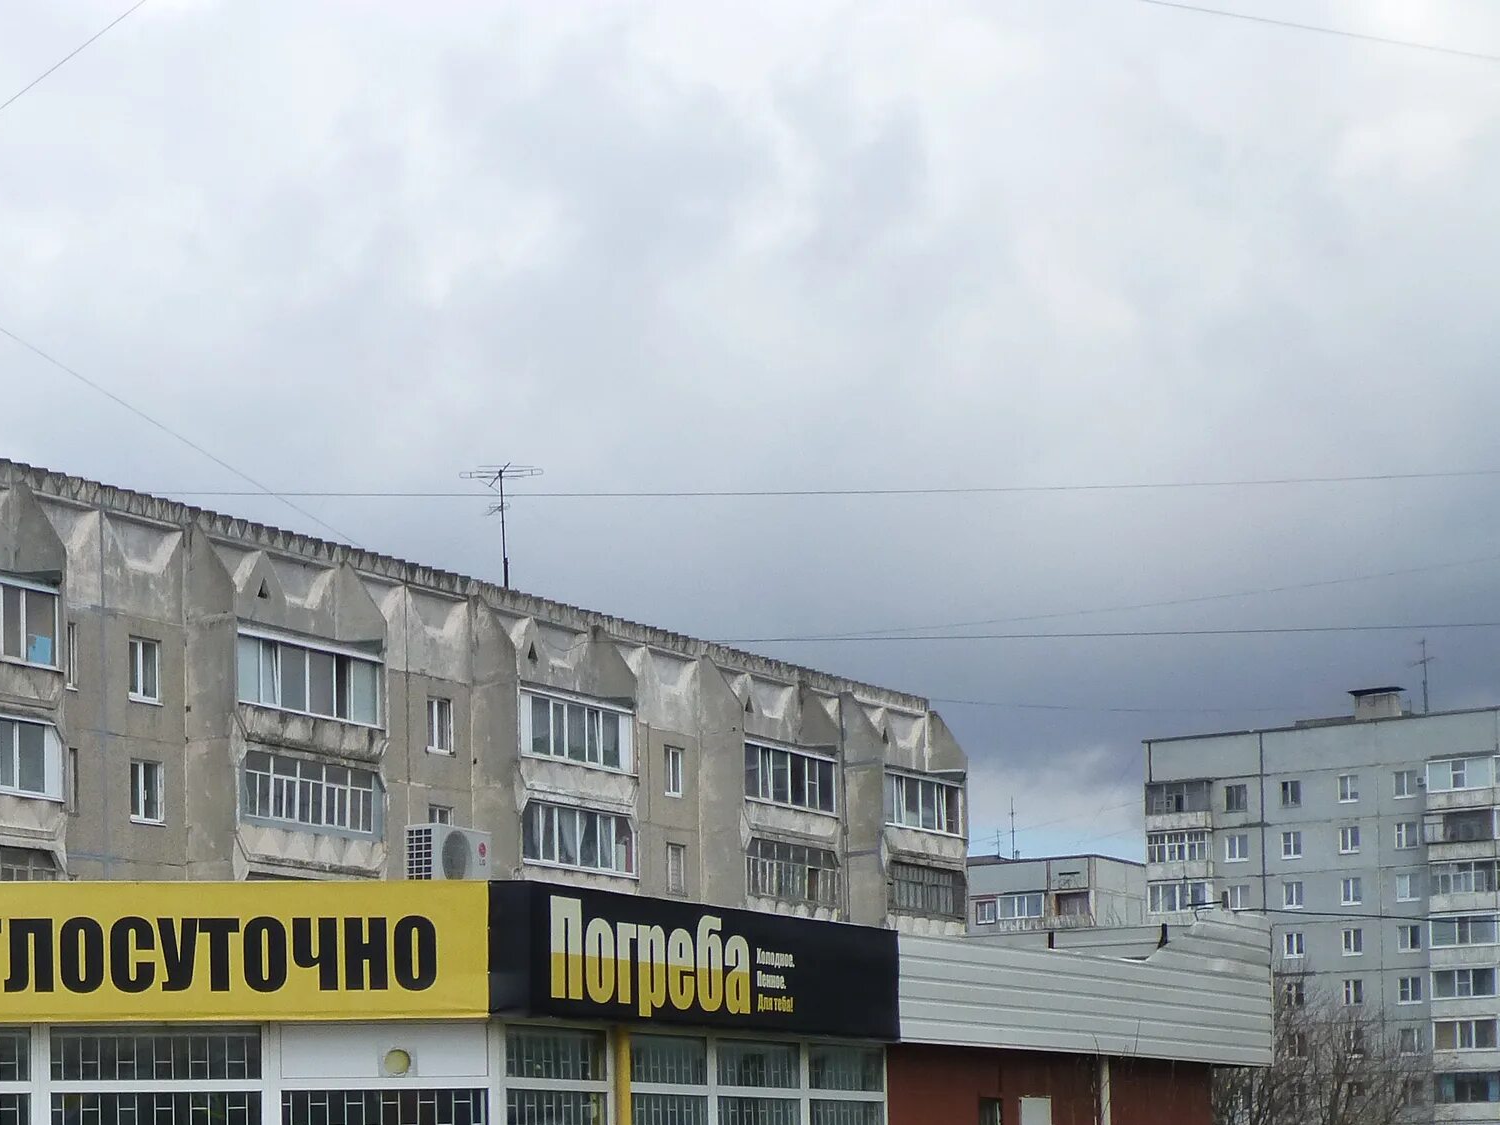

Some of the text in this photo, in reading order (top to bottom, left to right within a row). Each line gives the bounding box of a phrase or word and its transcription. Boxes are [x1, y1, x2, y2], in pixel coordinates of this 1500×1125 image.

[550, 895, 751, 1017] Погреба
[756, 947, 796, 969] Холодное.
[756, 970, 787, 989] Пенное.
[757, 993, 794, 1013] Для тебя!
